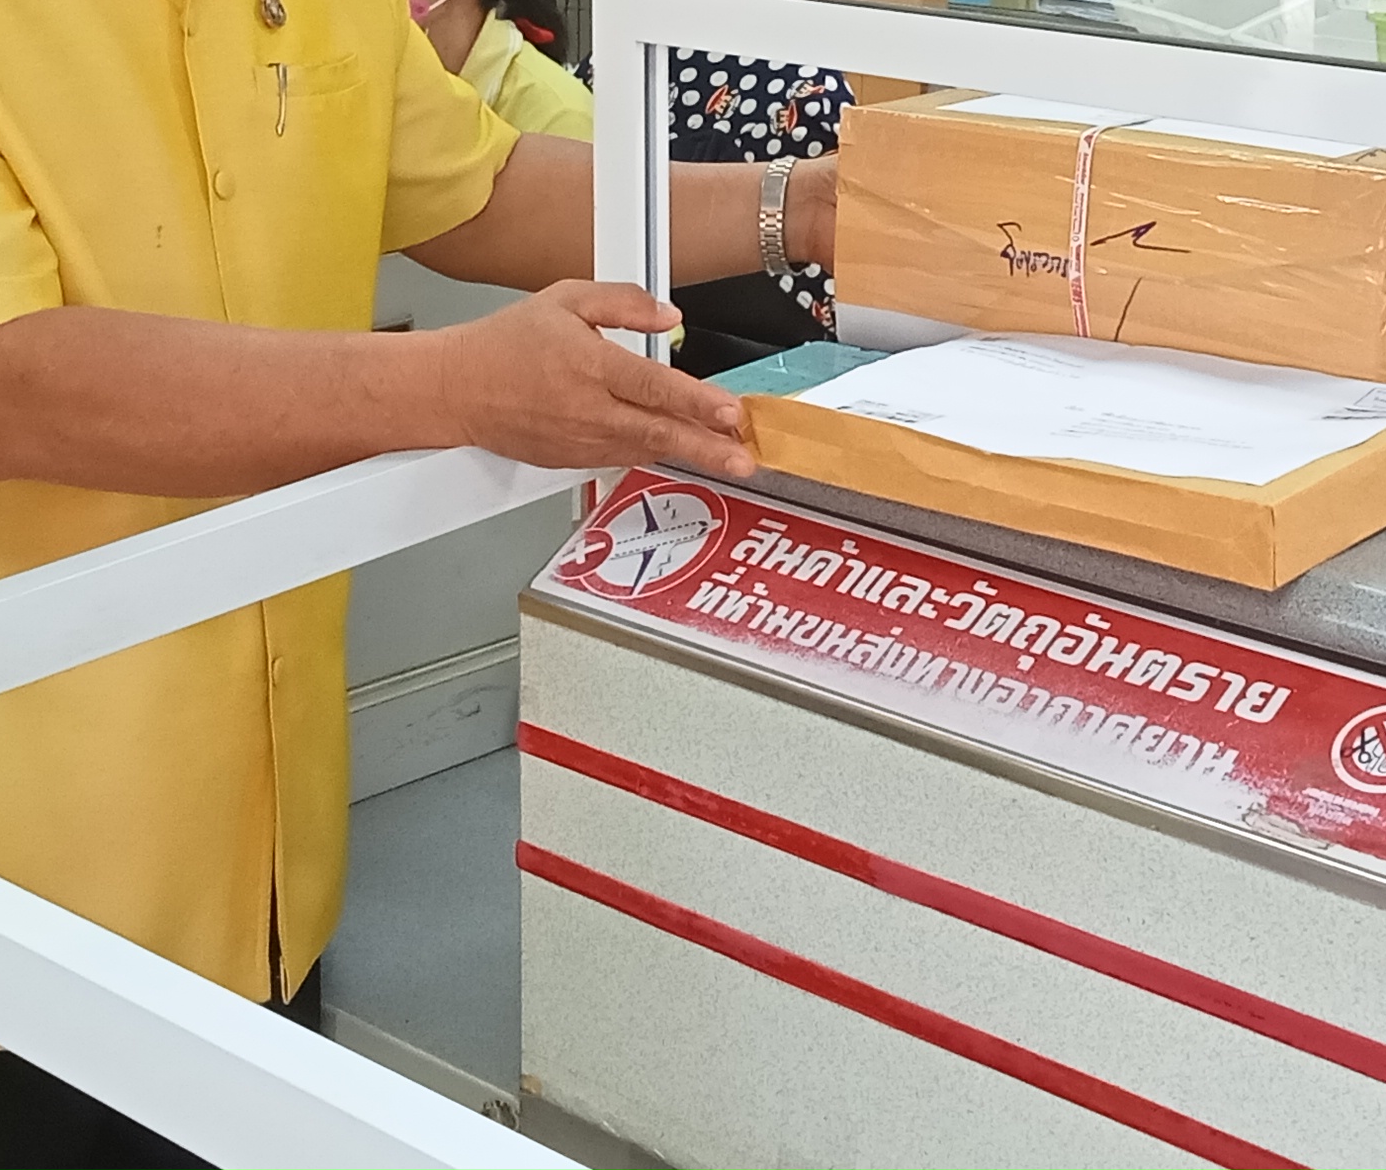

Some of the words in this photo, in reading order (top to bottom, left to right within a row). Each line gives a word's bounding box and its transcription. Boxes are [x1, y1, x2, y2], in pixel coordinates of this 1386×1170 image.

[684, 571, 1241, 780] ที่ห้ามขนส่งทางอากาศยาน
[727, 518, 1293, 724] สินค้าและวัตถุอันตราย
